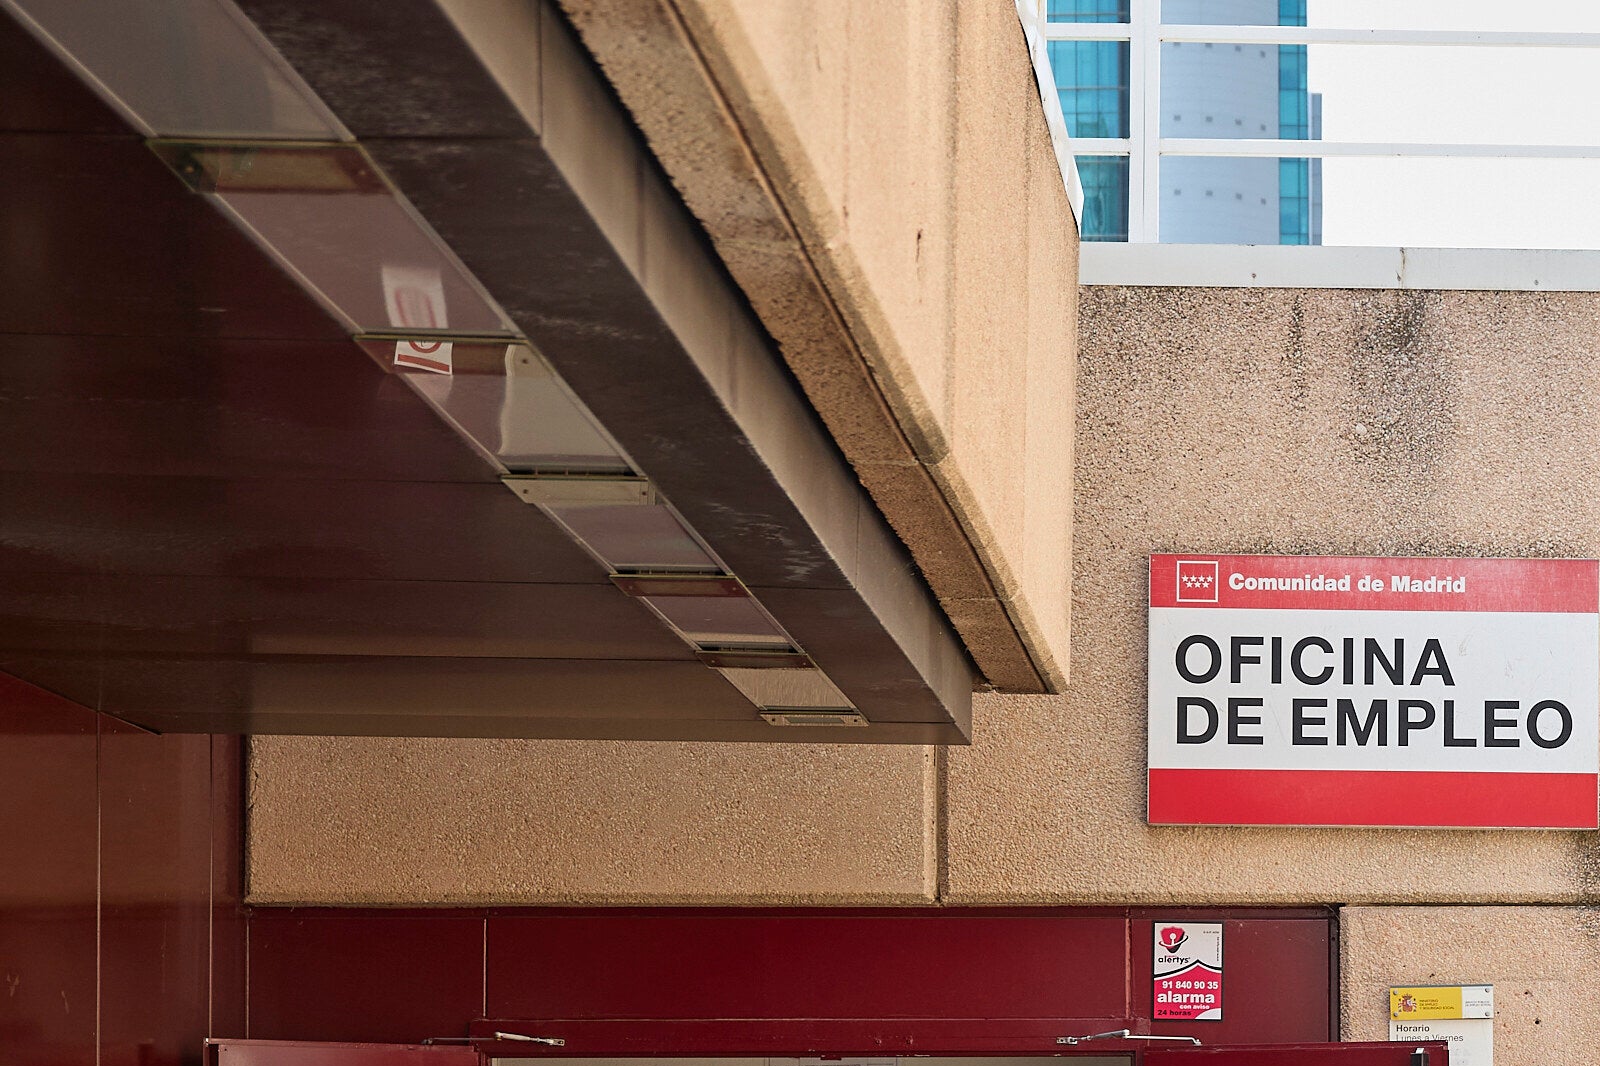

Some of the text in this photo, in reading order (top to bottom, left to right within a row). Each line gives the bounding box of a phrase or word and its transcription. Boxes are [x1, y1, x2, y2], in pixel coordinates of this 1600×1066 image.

[1228, 573, 1466, 593] Comunidad de Madrid
[1175, 634, 1455, 686] OFICINA
[1176, 697, 1573, 749] DE EMPLEO
[1158, 956, 1189, 964] alertys
[1162, 981, 1219, 989] 91 840 90 35
[1157, 991, 1215, 1003] alarma
[1396, 1024, 1430, 1032] Horario
[1431, 1034, 1464, 1042] Viernes
